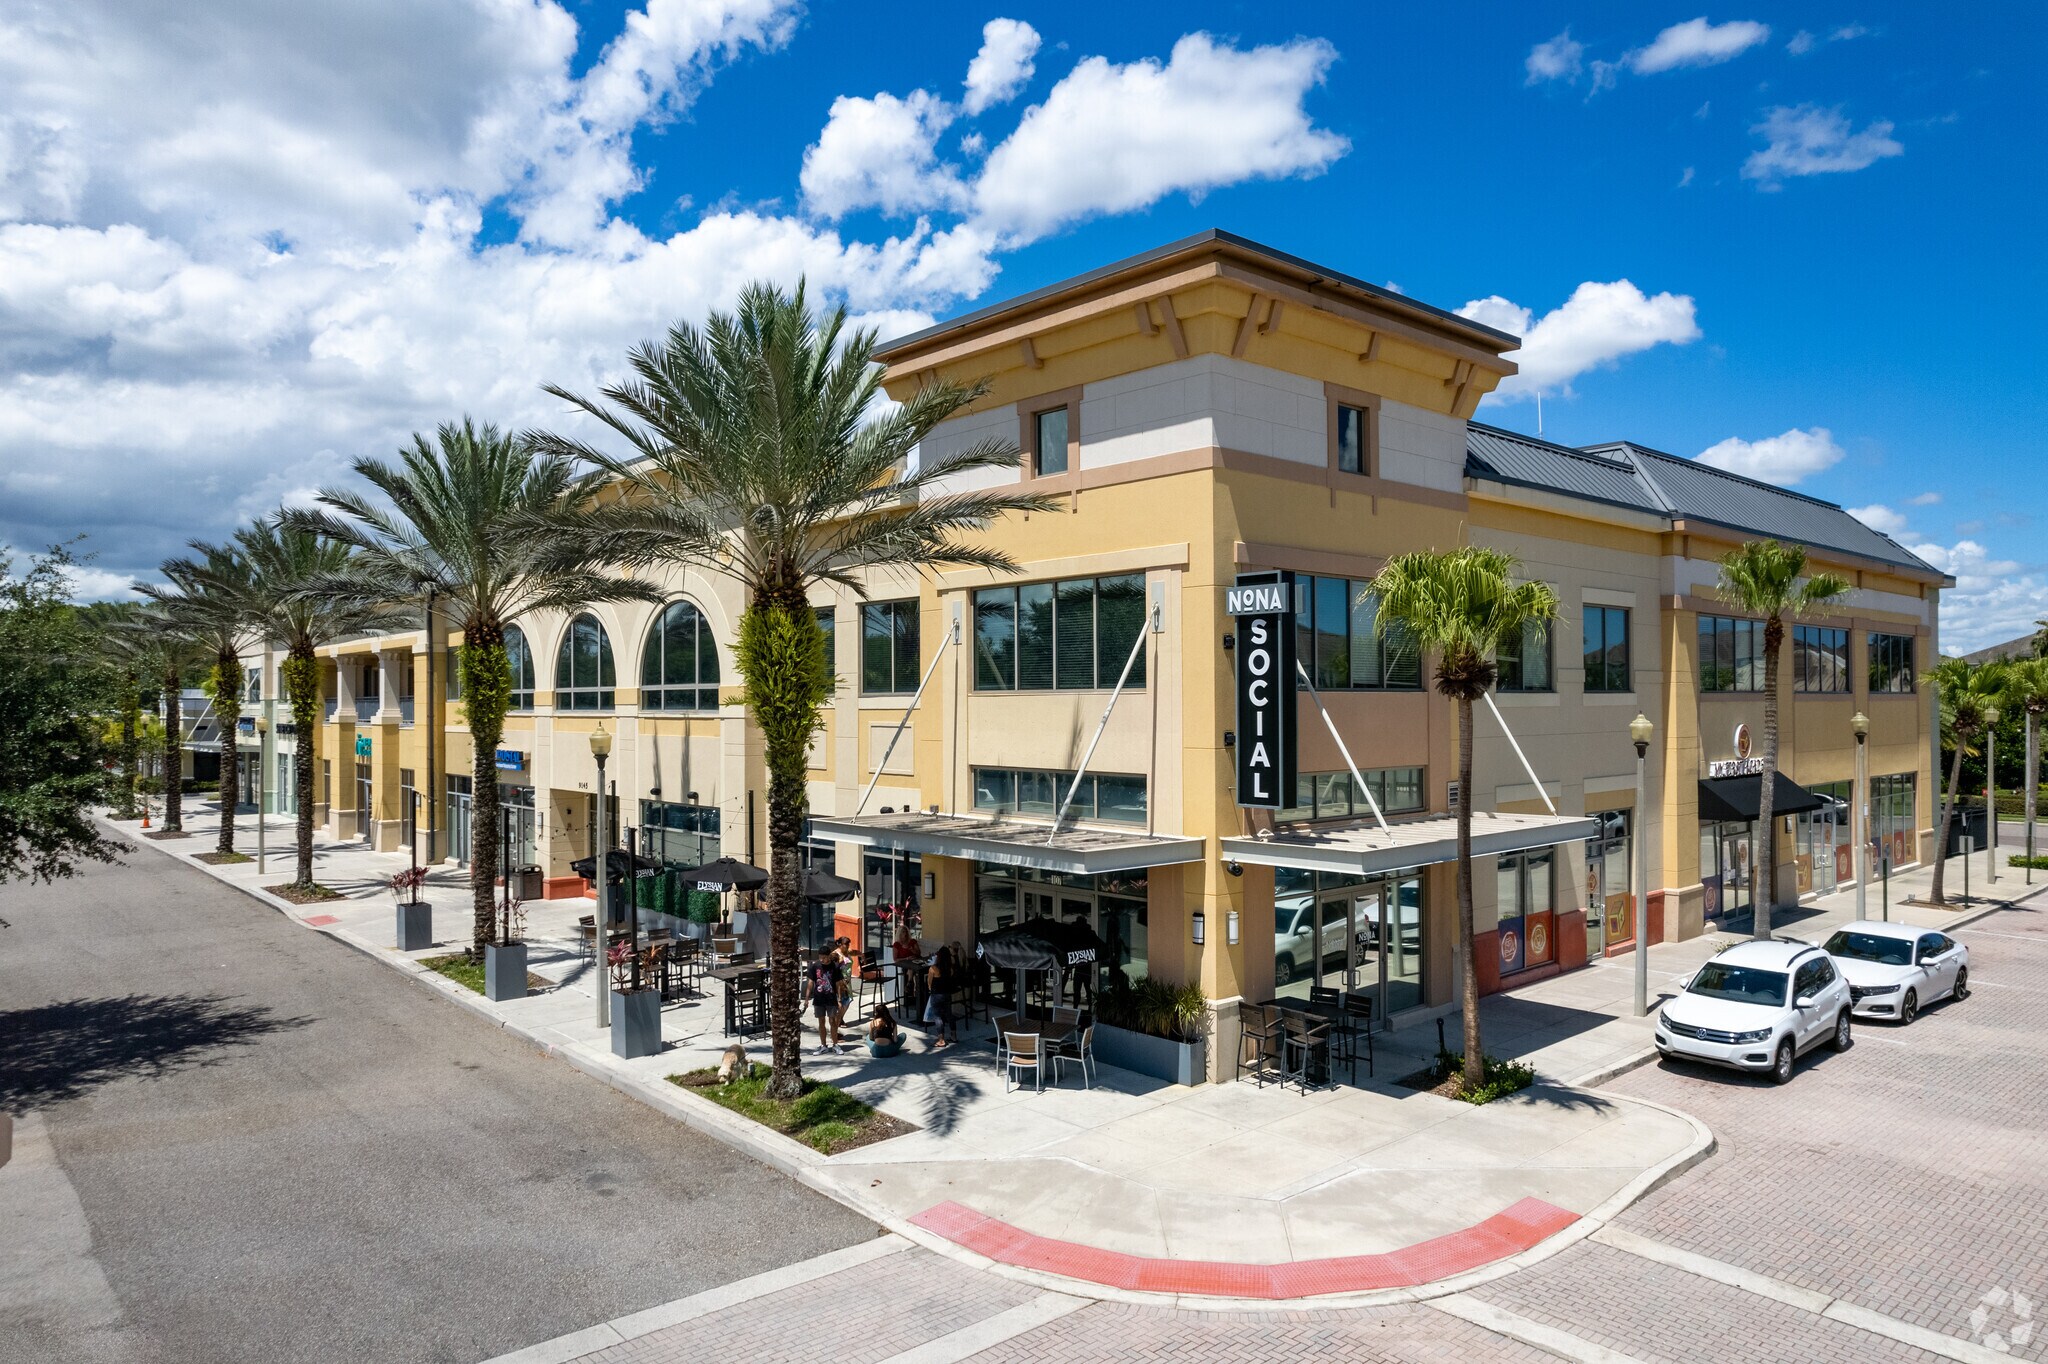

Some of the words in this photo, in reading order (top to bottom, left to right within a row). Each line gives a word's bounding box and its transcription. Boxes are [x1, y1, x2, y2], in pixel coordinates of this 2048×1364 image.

[1228, 586, 1283, 614] NONA
[1248, 618, 1271, 799] SOCIAL
[635, 868, 655, 878] LYSIAN
[697, 880, 723, 892] ELYSIAN
[1067, 948, 1096, 965] ELYSIAN
